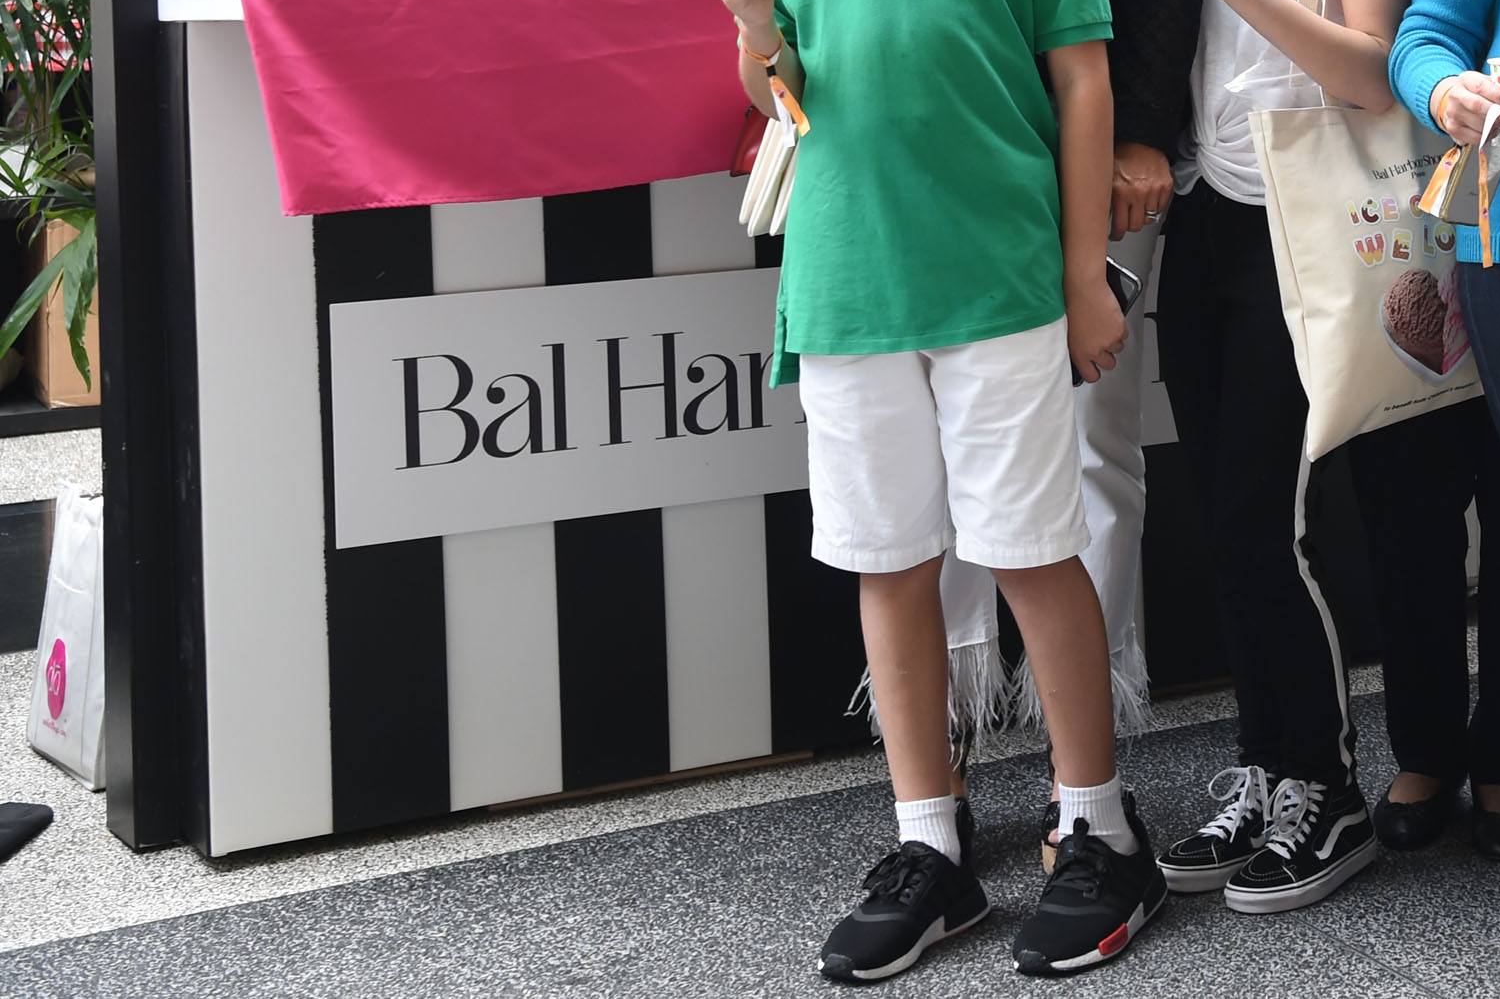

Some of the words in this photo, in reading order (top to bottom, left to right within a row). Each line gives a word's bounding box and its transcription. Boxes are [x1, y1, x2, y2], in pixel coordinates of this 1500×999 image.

[1344, 195, 1400, 226] ICE
[1353, 228, 1413, 266] WE
[1422, 222, 1457, 257] LO
[392, 342, 578, 471] Bal
[596, 331, 807, 447] Har
